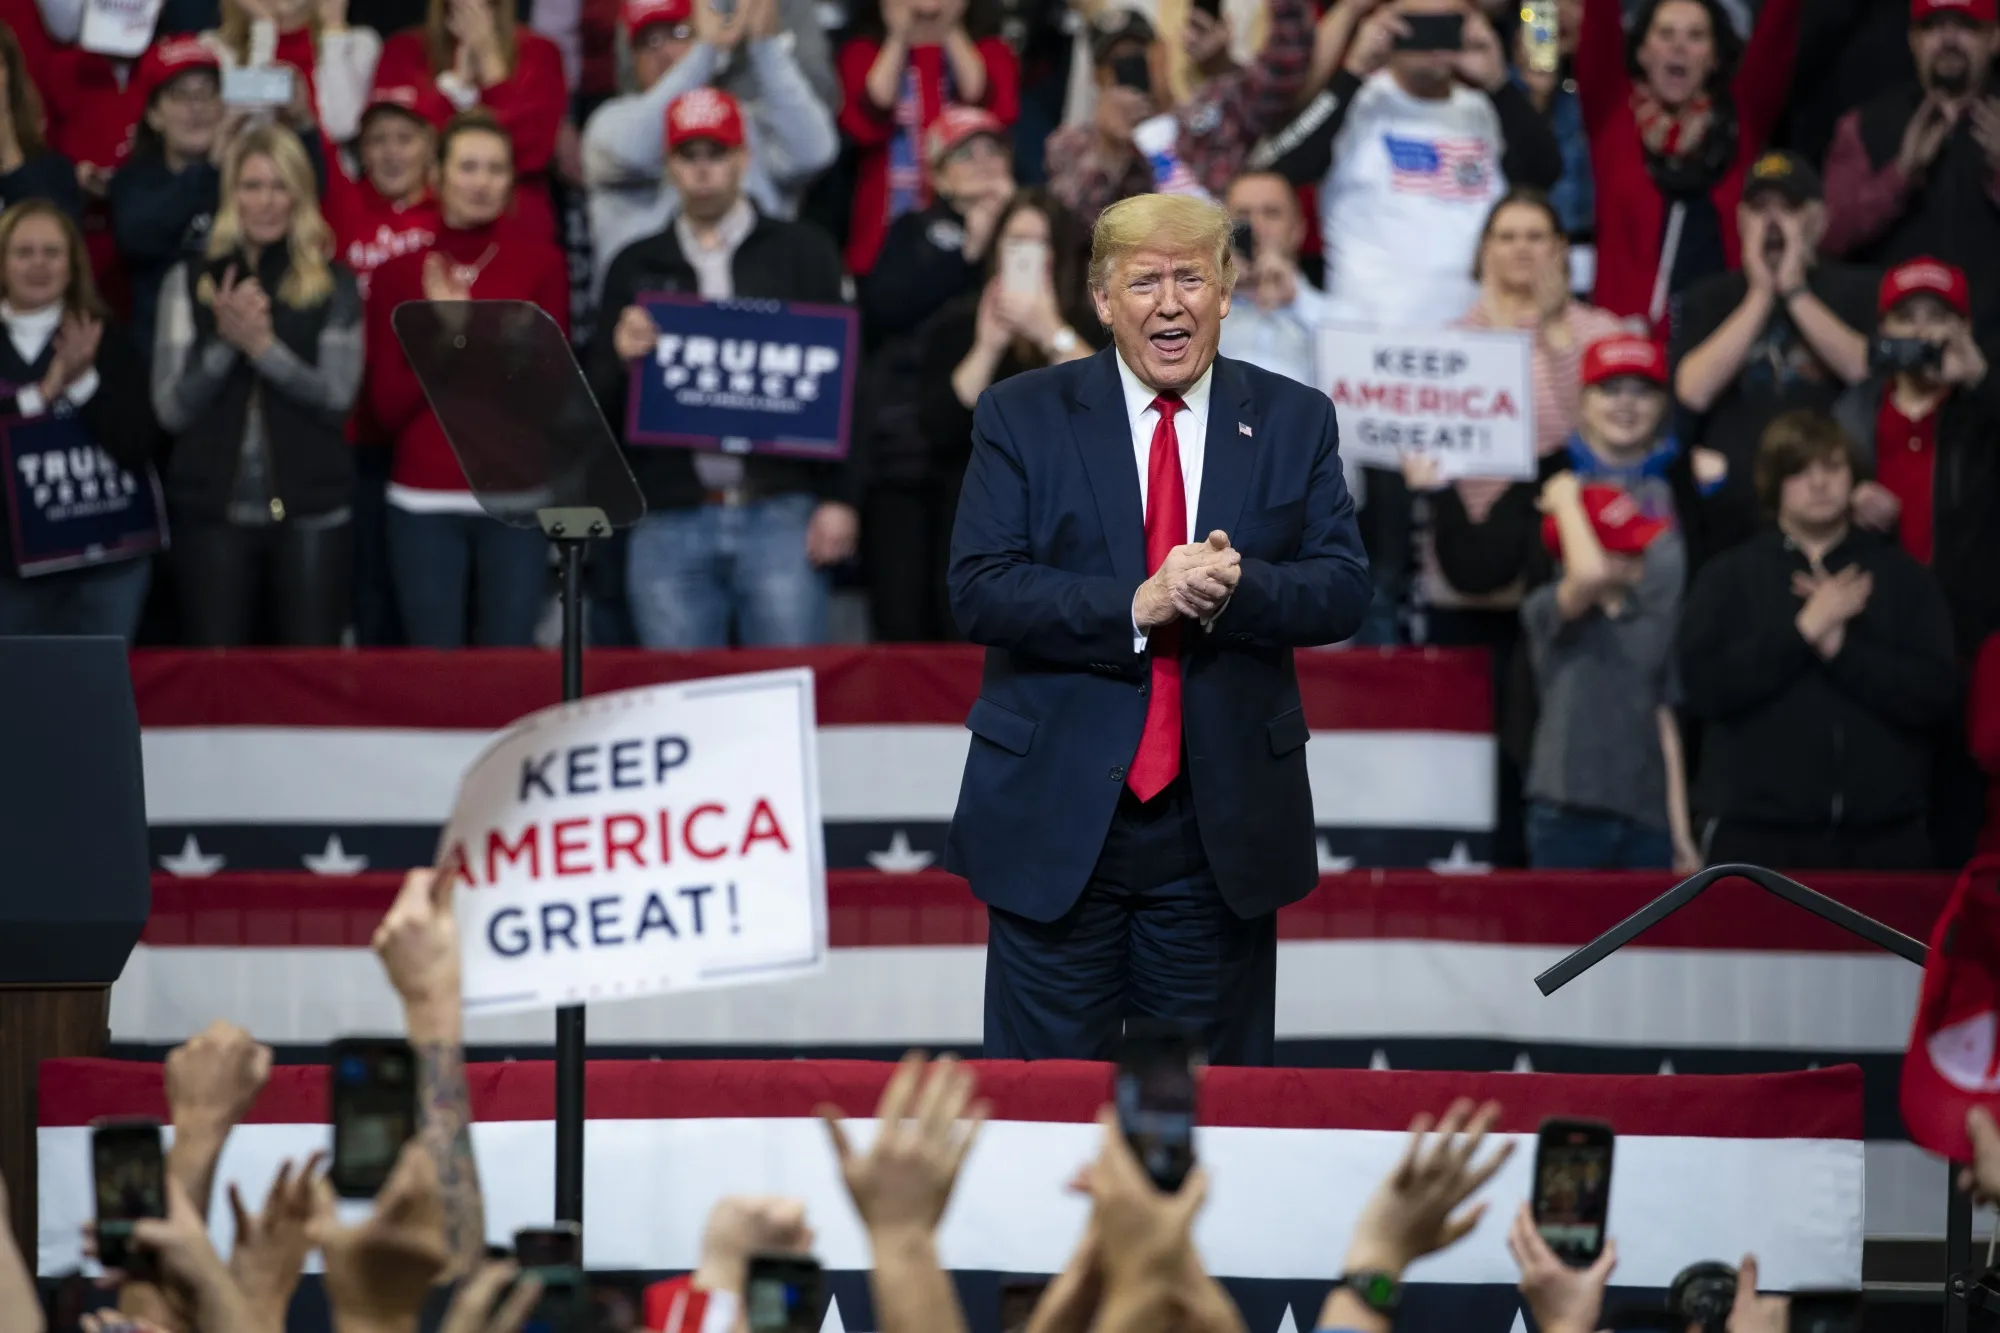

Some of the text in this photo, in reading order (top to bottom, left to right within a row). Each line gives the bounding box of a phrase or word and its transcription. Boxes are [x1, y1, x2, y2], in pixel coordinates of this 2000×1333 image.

[656, 332, 840, 378] TRUMP
[1373, 347, 1469, 376] KEEP
[1331, 379, 1519, 420] AMERICA
[1356, 418, 1492, 450] GREAT!
[518, 735, 691, 803] KEEP
[447, 796, 792, 889] AMERICA
[486, 880, 741, 959] GREAT!
